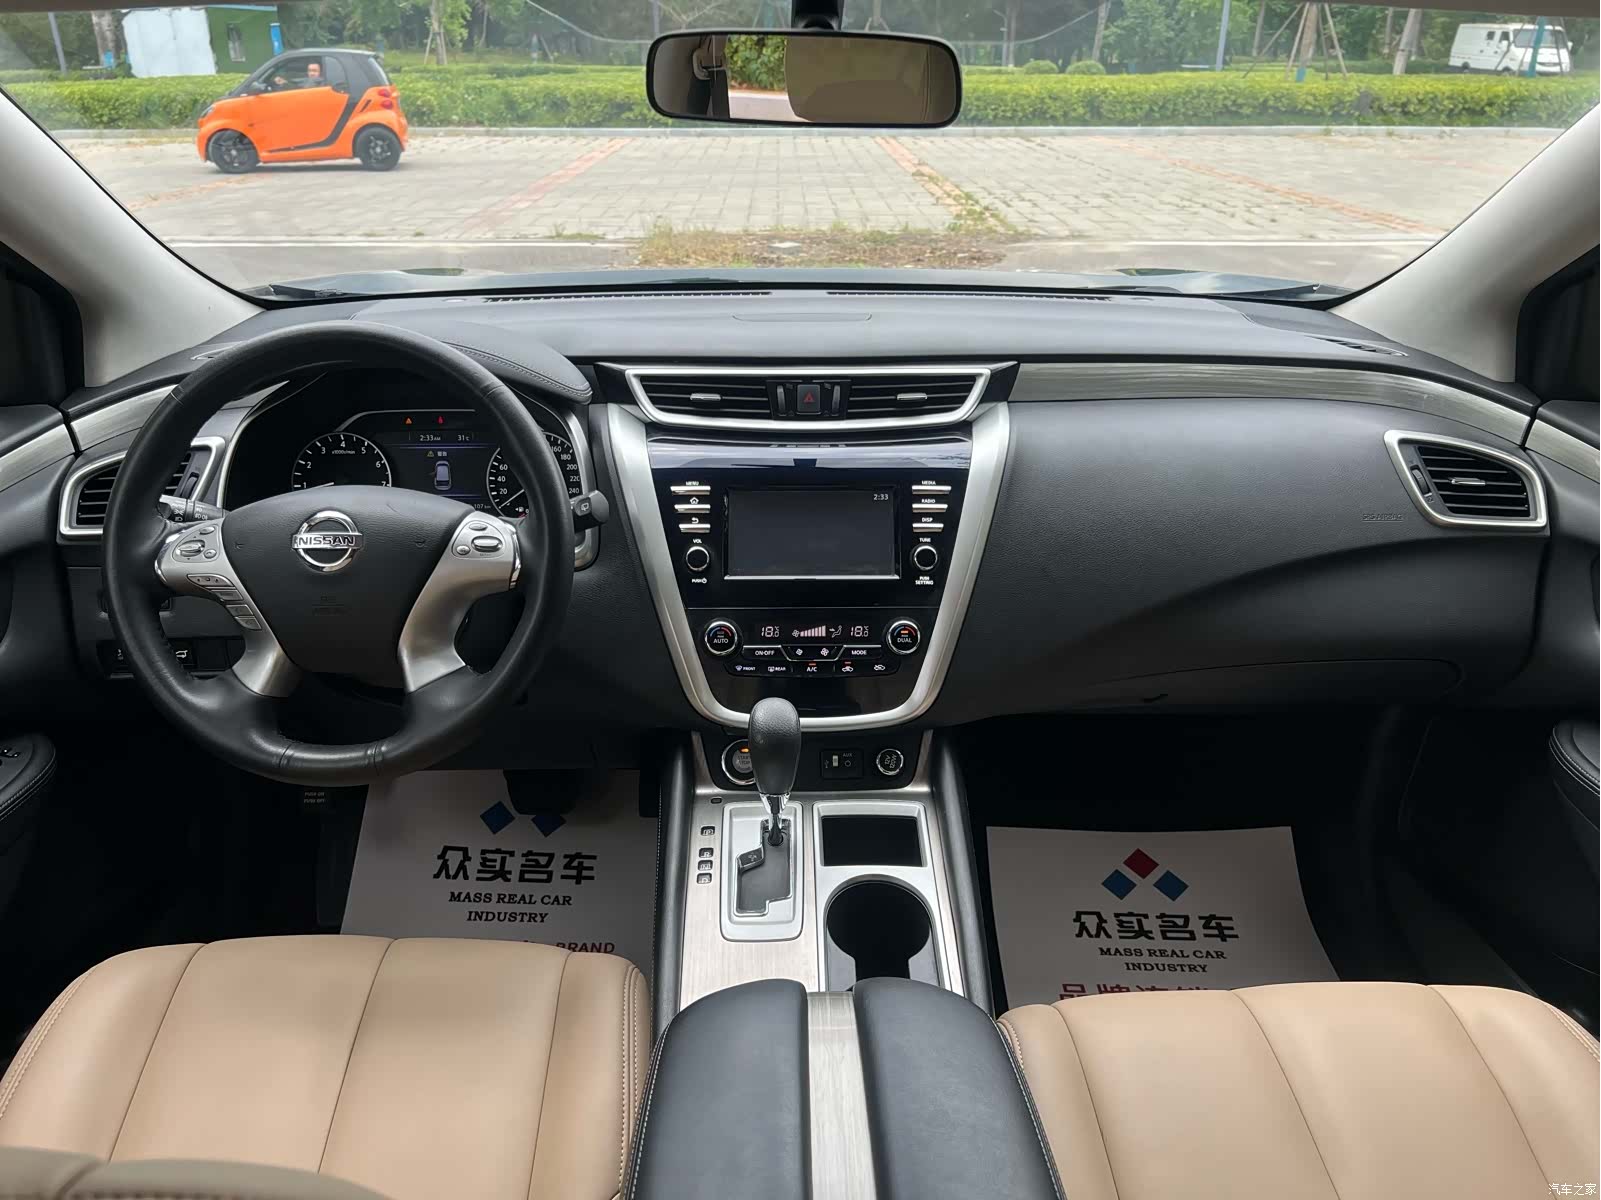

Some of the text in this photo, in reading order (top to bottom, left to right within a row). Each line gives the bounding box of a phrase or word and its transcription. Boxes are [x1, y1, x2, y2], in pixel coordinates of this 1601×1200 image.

[321, 446, 326, 455] 3
[361, 446, 367, 455] 5
[551, 445, 562, 453] 160
[560, 453, 571, 461] 180
[306, 461, 312, 469] 2
[375, 460, 381, 469] 6
[566, 463, 578, 471] 200
[873, 493, 889, 501] 2:33
[298, 536, 356, 546] NISSAN
[433, 845, 597, 885] 众实名车
[449, 891, 573, 906] MASS REAL CAR
[466, 911, 549, 923] INDUSTRY
[1072, 910, 1240, 942] 众实名车
[1099, 947, 1227, 959] MASS REAL CAR
[1124, 962, 1209, 973] INDUSTRY
